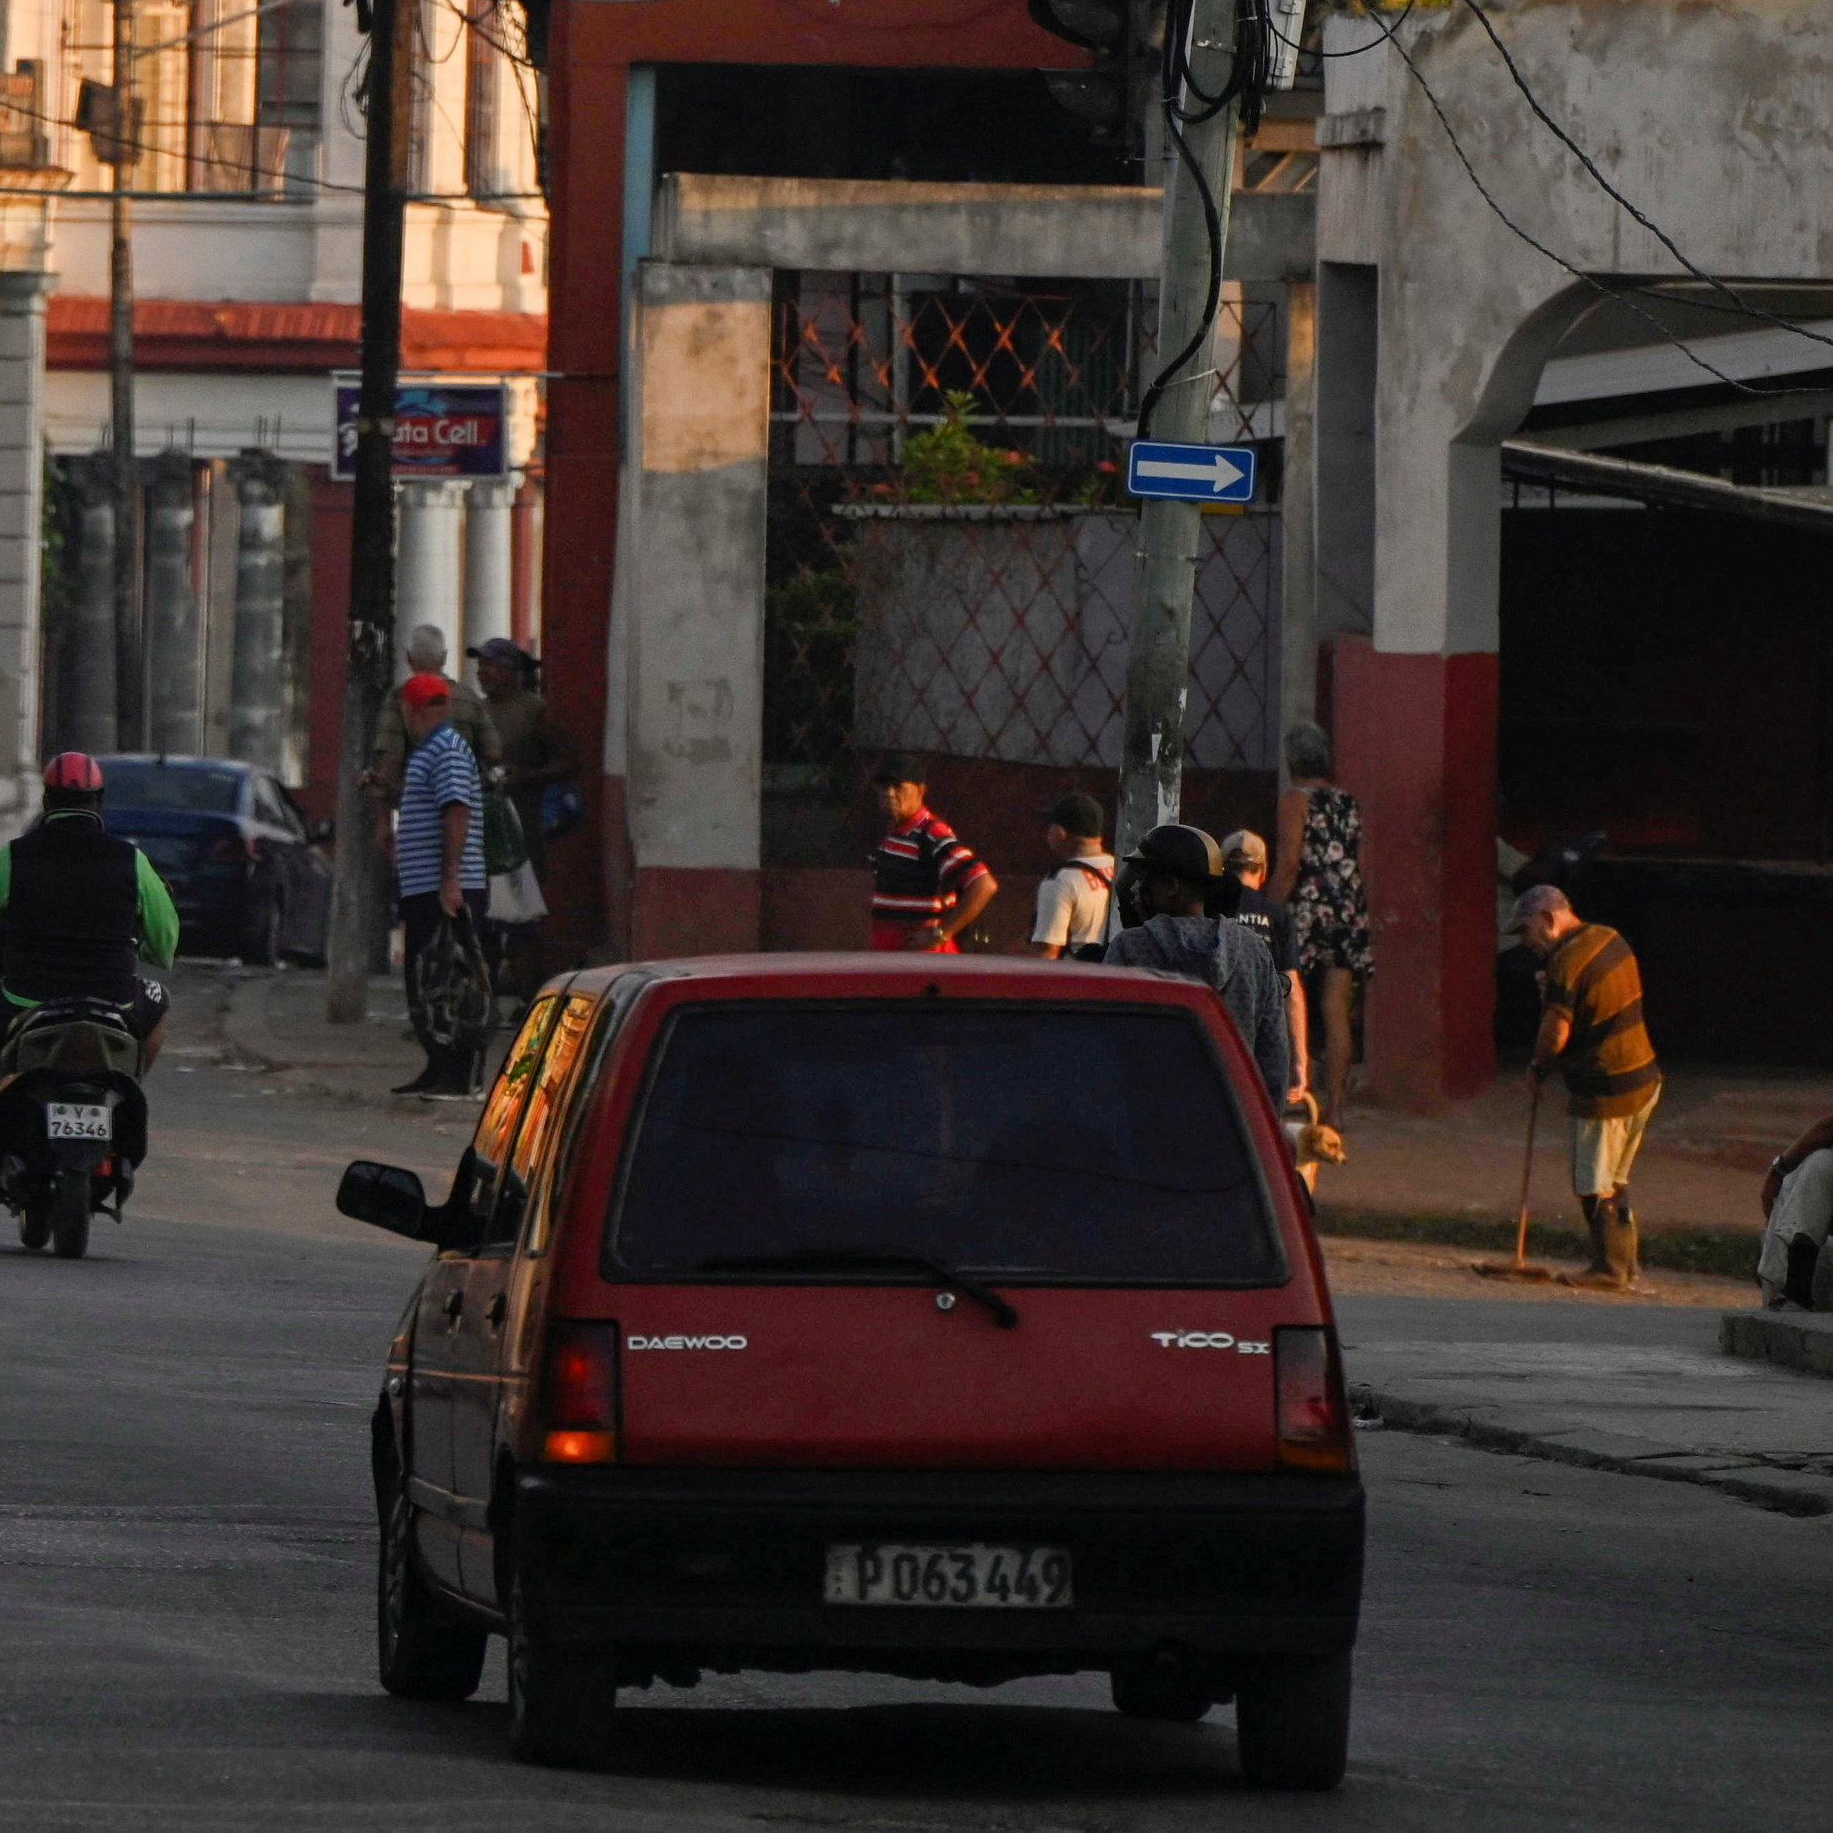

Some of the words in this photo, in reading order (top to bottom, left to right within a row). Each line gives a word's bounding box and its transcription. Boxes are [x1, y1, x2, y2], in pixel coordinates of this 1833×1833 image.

[434, 419, 478, 445] Cell
[52, 1121, 107, 1138] 76346
[627, 1336, 748, 1350] DAEWOO
